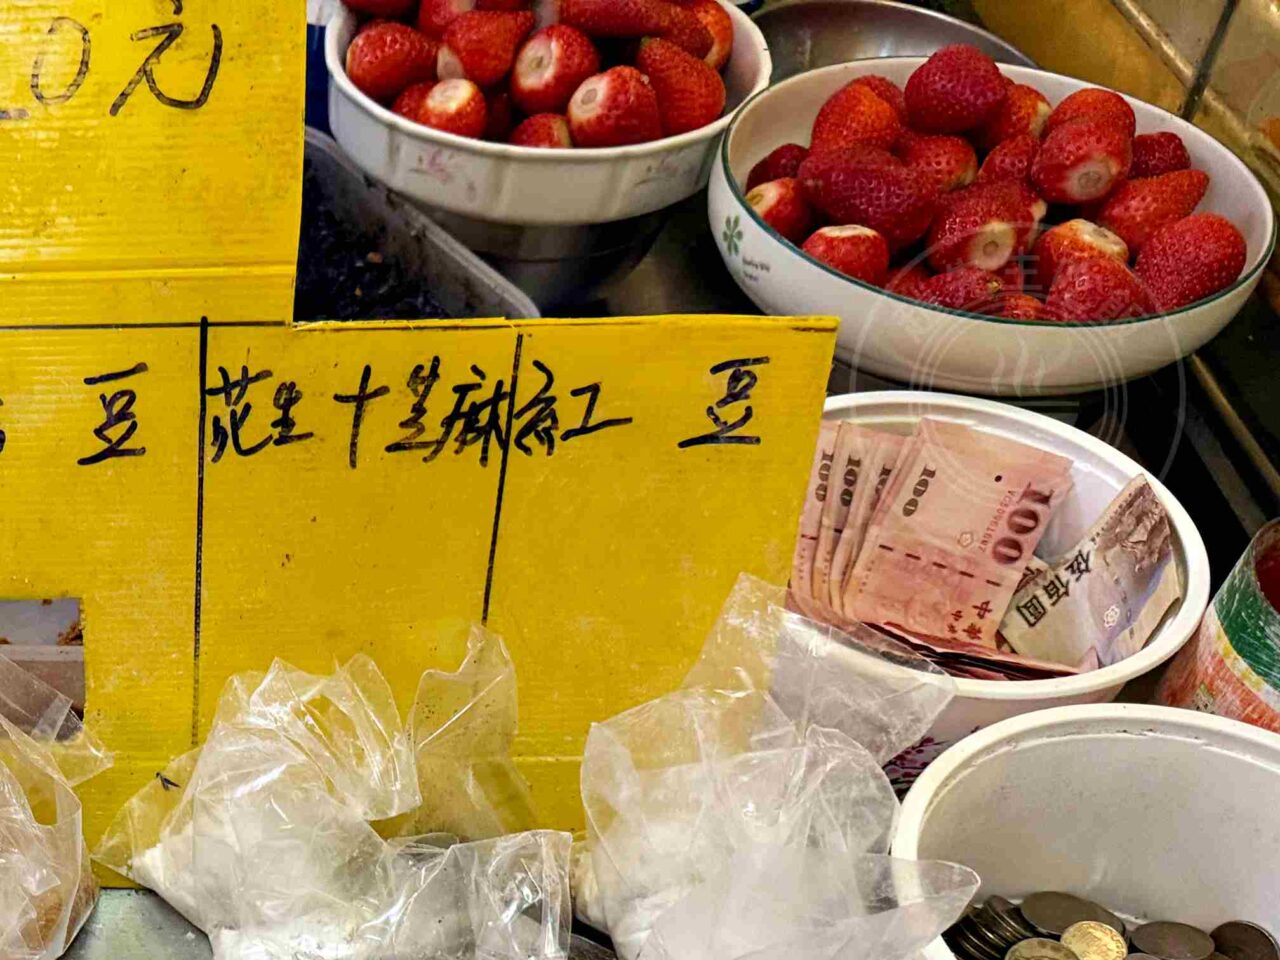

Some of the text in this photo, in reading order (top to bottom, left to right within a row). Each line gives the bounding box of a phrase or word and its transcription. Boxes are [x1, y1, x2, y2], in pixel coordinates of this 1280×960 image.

[513, 355, 771, 457] 紅豆
[840, 454, 862, 507] 100
[902, 464, 937, 518] 100
[991, 481, 1055, 566] 100
[1015, 549, 1092, 628] 伍佰圓
